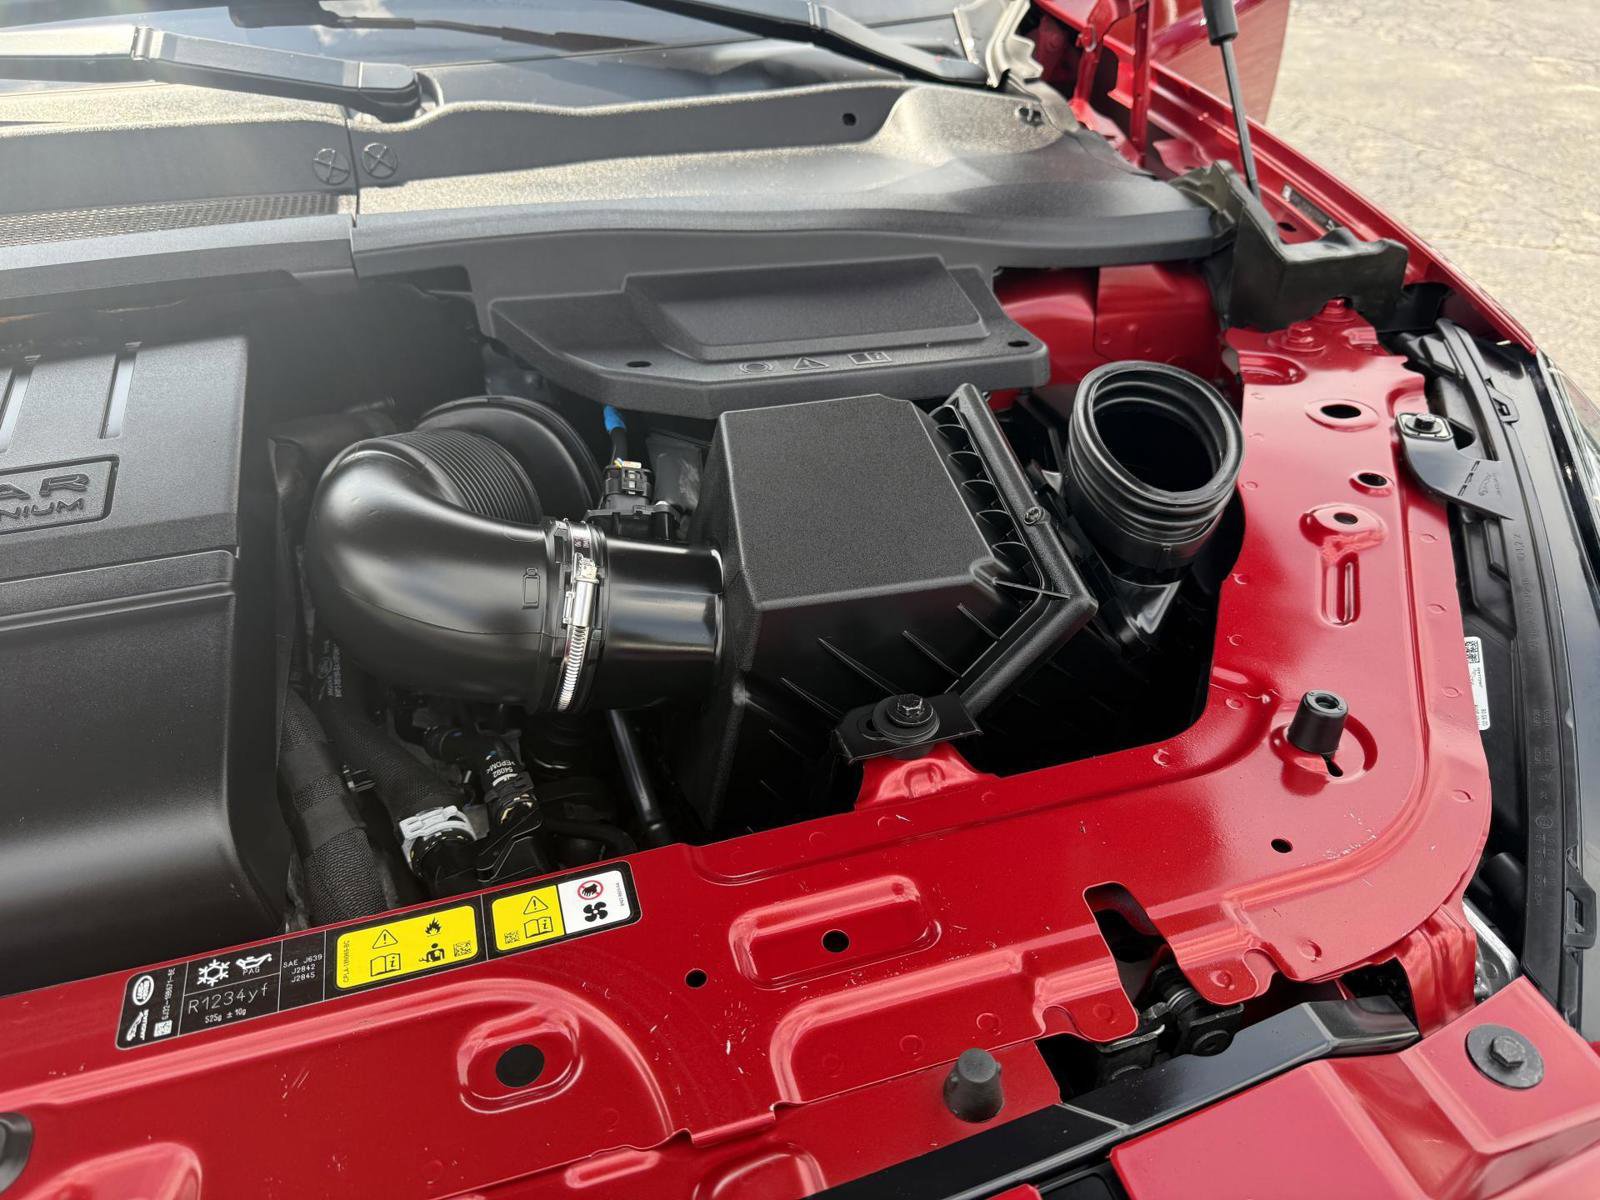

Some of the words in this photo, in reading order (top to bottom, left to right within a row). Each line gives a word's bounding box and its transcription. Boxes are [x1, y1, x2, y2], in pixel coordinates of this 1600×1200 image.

[283, 960, 298, 969] SAE
[303, 953, 323, 964] J639
[242, 967, 260, 976] PAG
[188, 982, 269, 1014] R1234yf
